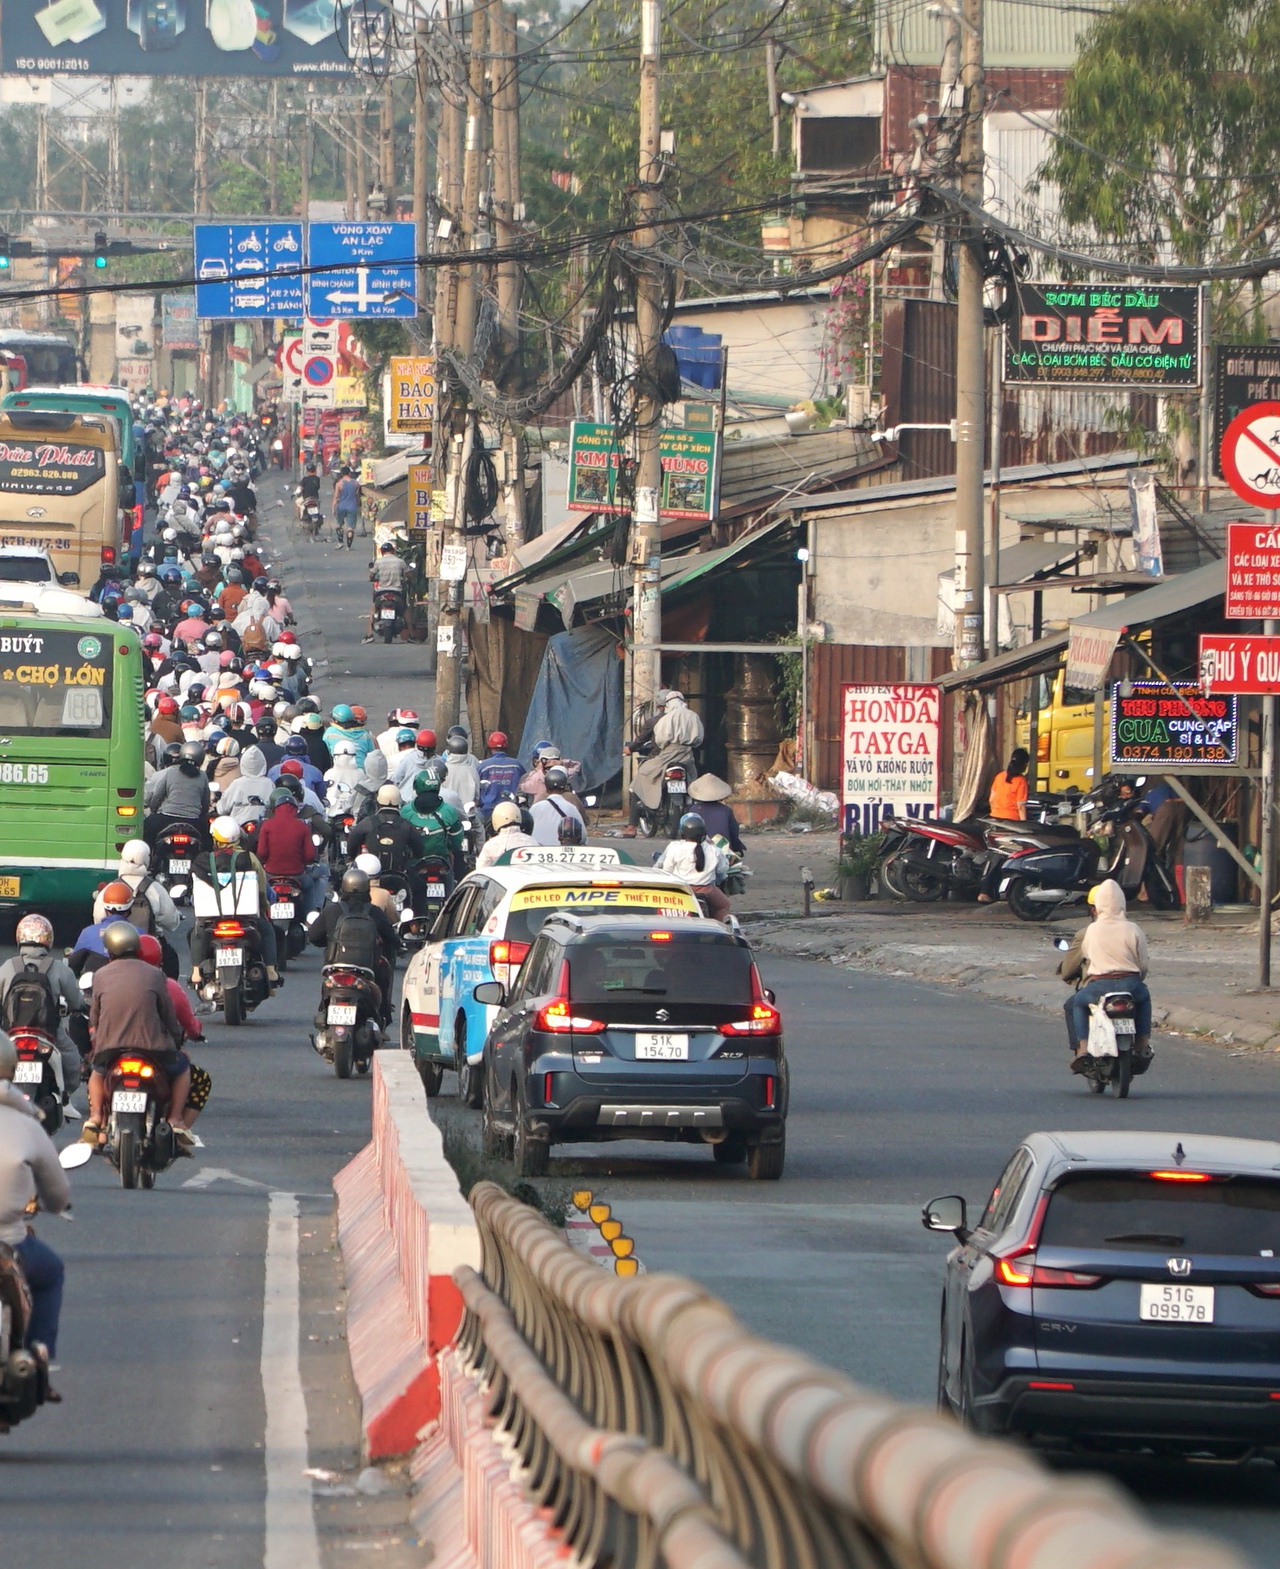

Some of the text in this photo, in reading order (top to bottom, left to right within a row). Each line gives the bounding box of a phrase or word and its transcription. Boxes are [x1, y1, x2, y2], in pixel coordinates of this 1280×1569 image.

[332, 223, 393, 235] VÒNG XOAY
[342, 236, 384, 248] AN LẠC
[270, 287, 301, 297] XE 2 VÀ
[1045, 292, 1087, 307] BƠM
[1124, 289, 1160, 309] DẦU
[277, 299, 302, 310] BÁNH
[1020, 306, 1184, 345] DIỄM
[1012, 350, 1037, 367] CÁC
[1038, 354, 1062, 368] LOẠI
[1063, 353, 1089, 367] BƠM
[1111, 351, 1133, 367] DẦU
[1135, 353, 1154, 368] CƠ
[1154, 353, 1179, 371] ĐIỆN
[575, 450, 607, 468] KIM
[1255, 527, 1280, 549] CẤ
[1234, 551, 1280, 570] CÁC LOẠI XE
[1231, 570, 1242, 586] VÀ
[1243, 572, 1254, 586] XE
[0, 633, 44, 654] BUÝT
[1213, 642, 1236, 682] HÚ
[1240, 643, 1252, 682] Ý
[15, 664, 60, 688] CHỢ
[64, 662, 106, 686] LỚN
[848, 699, 934, 724] HONDA
[1120, 699, 1158, 717] THU
[1118, 718, 1170, 744] CUA
[1168, 720, 1206, 732] CUNG
[850, 731, 932, 756] TAYGA
[1194, 734, 1203, 745] &
[1122, 746, 1227, 760] 0374 190 138
[846, 756, 858, 774] VÁ
[876, 757, 908, 774] KHÔNG
[909, 757, 935, 777] RUỘT
[538, 852, 616, 864] 38.27 27 27
[544, 894, 561, 902] LED
[565, 890, 622, 903] MPE
[624, 891, 650, 903] THIẾT
[651, 1035, 673, 1047] 51K
[643, 1047, 683, 1059] 154.70
[117, 1092, 143, 1103] 59-P3
[1162, 1286, 1194, 1303] 51G
[1149, 1303, 1207, 1321] 099.78
[1040, 1322, 1078, 1334] CR-V
